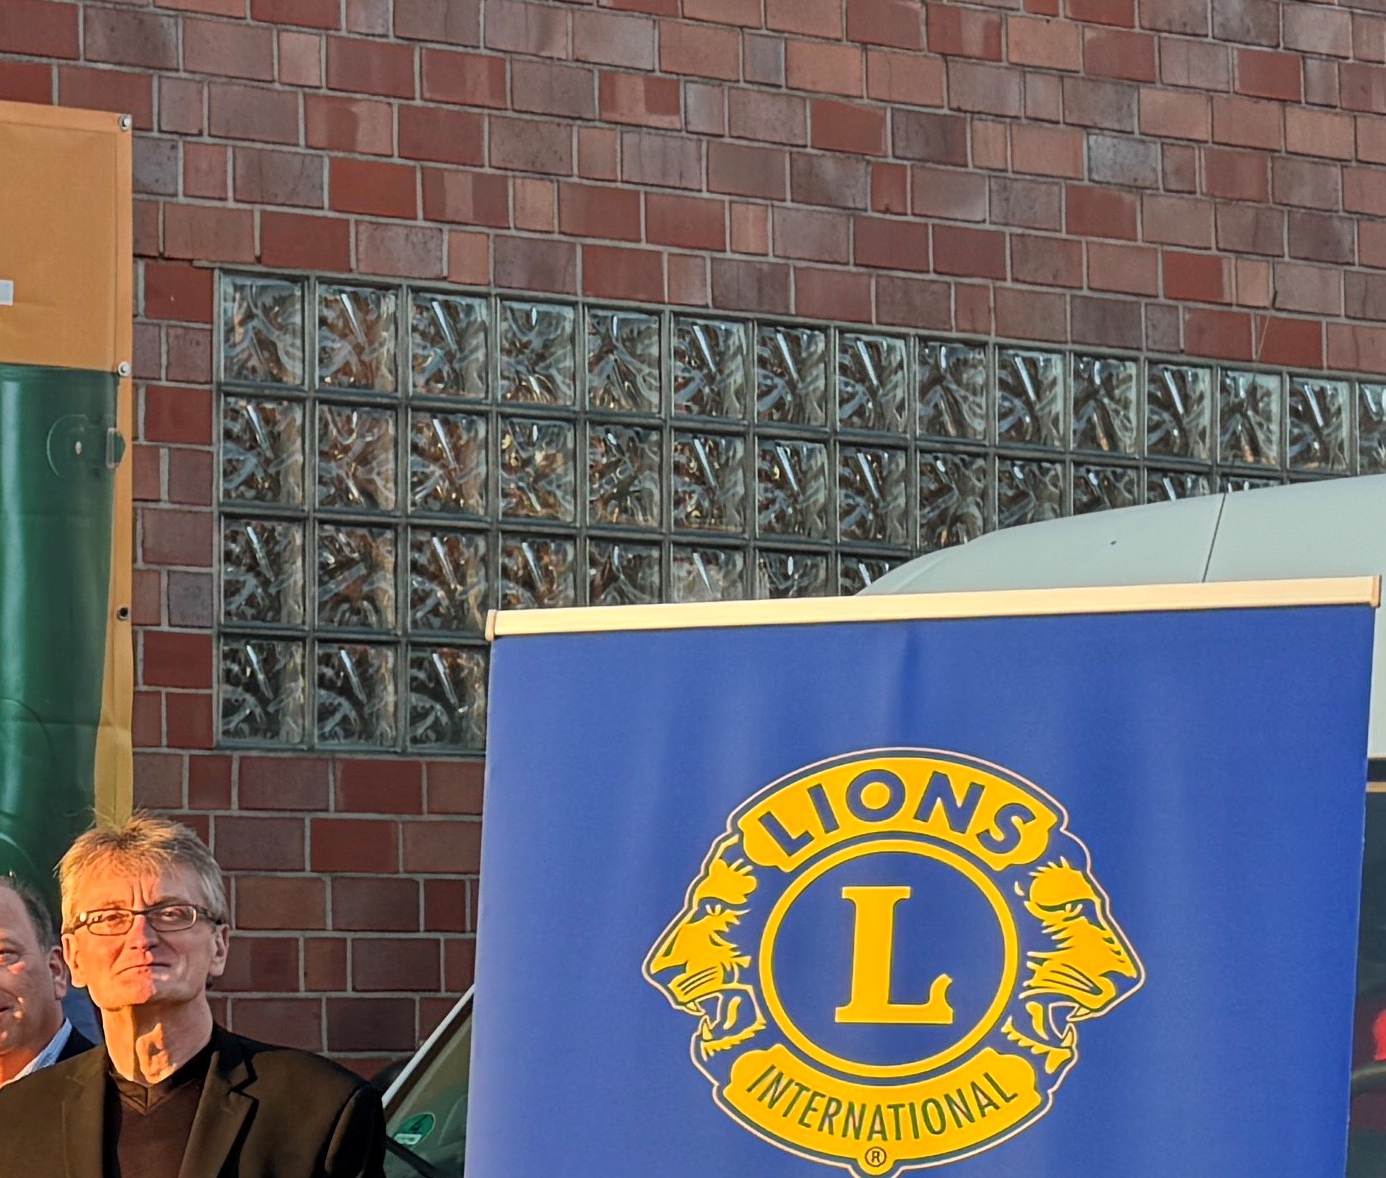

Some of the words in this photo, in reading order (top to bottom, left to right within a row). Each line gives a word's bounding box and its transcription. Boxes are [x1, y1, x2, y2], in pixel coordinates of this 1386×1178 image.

[758, 769, 1036, 857] LIONS
[834, 885, 953, 1024] L
[746, 1065, 1018, 1141] INTERNATIONAL
